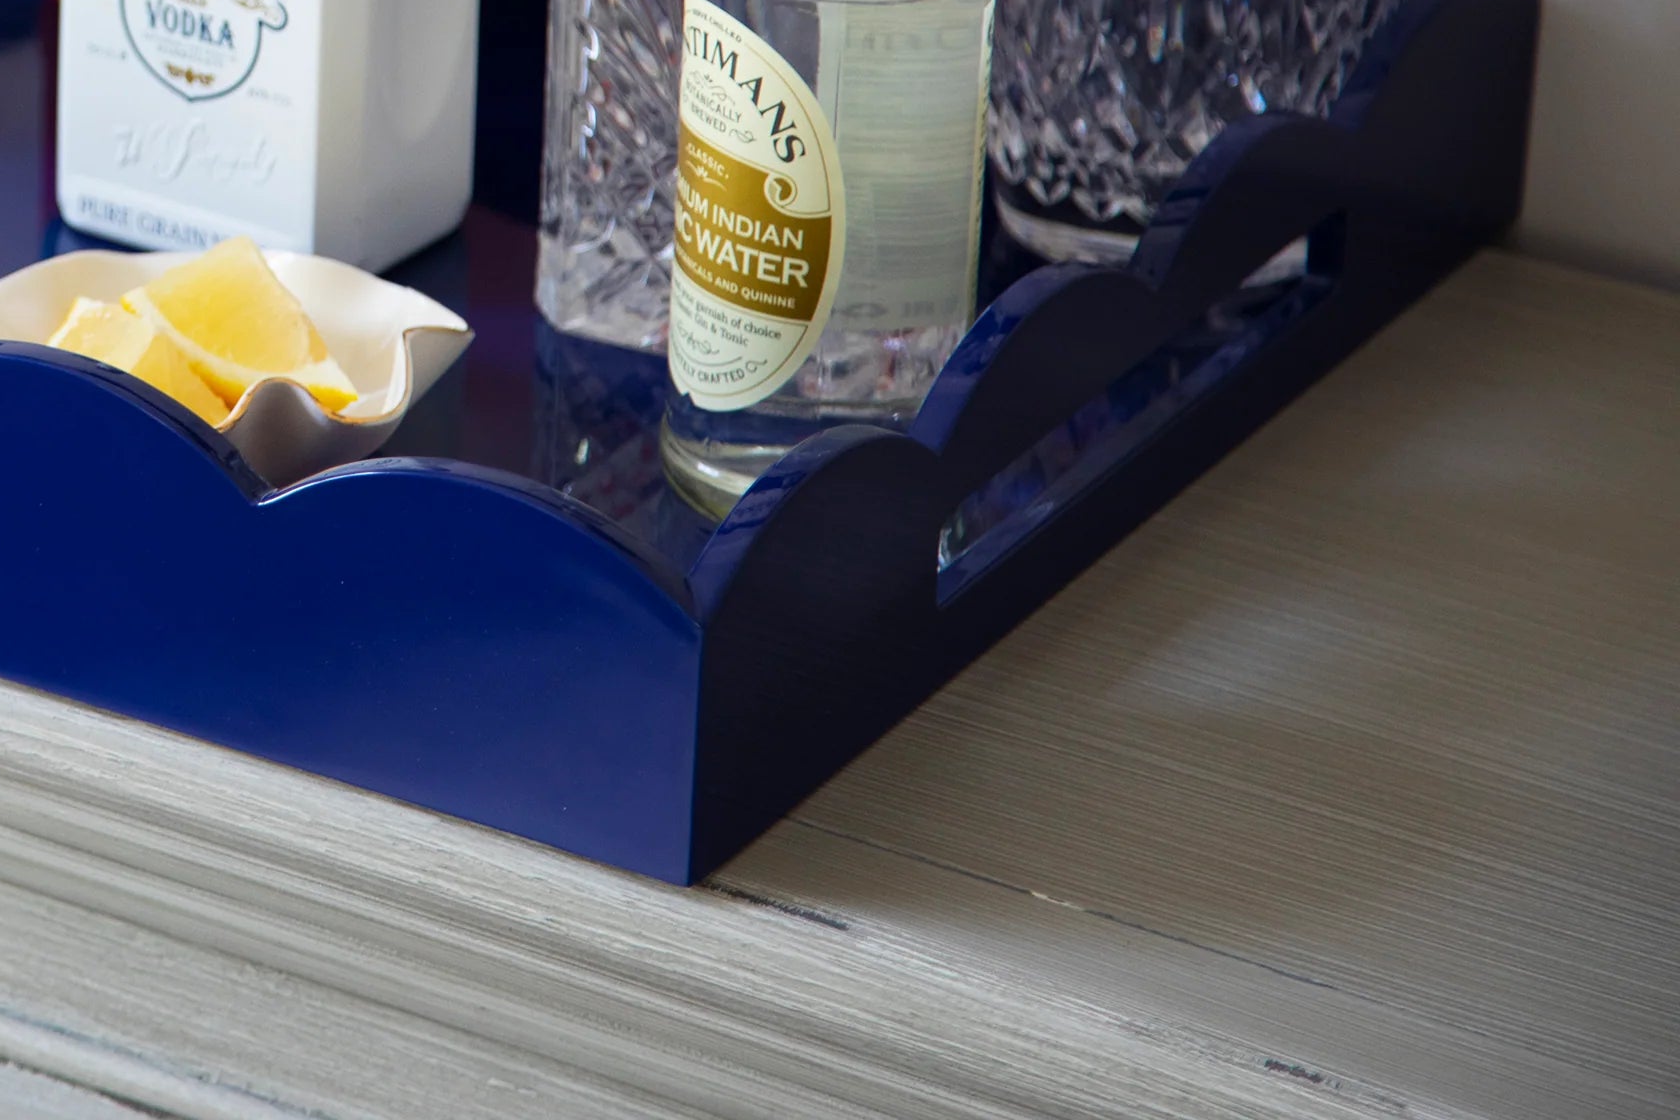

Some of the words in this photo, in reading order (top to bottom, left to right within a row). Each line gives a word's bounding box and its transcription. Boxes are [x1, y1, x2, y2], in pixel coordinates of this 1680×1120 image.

[691, 102, 727, 133] BREWED
[712, 204, 804, 251] INDIAN
[696, 221, 810, 288] WATER
[715, 276, 739, 295] AND
[741, 287, 796, 310] QUININE
[720, 326, 750, 348] Tonic
[731, 318, 743, 331] of
[744, 322, 782, 341] choice
[697, 368, 746, 386] CRAFTED
